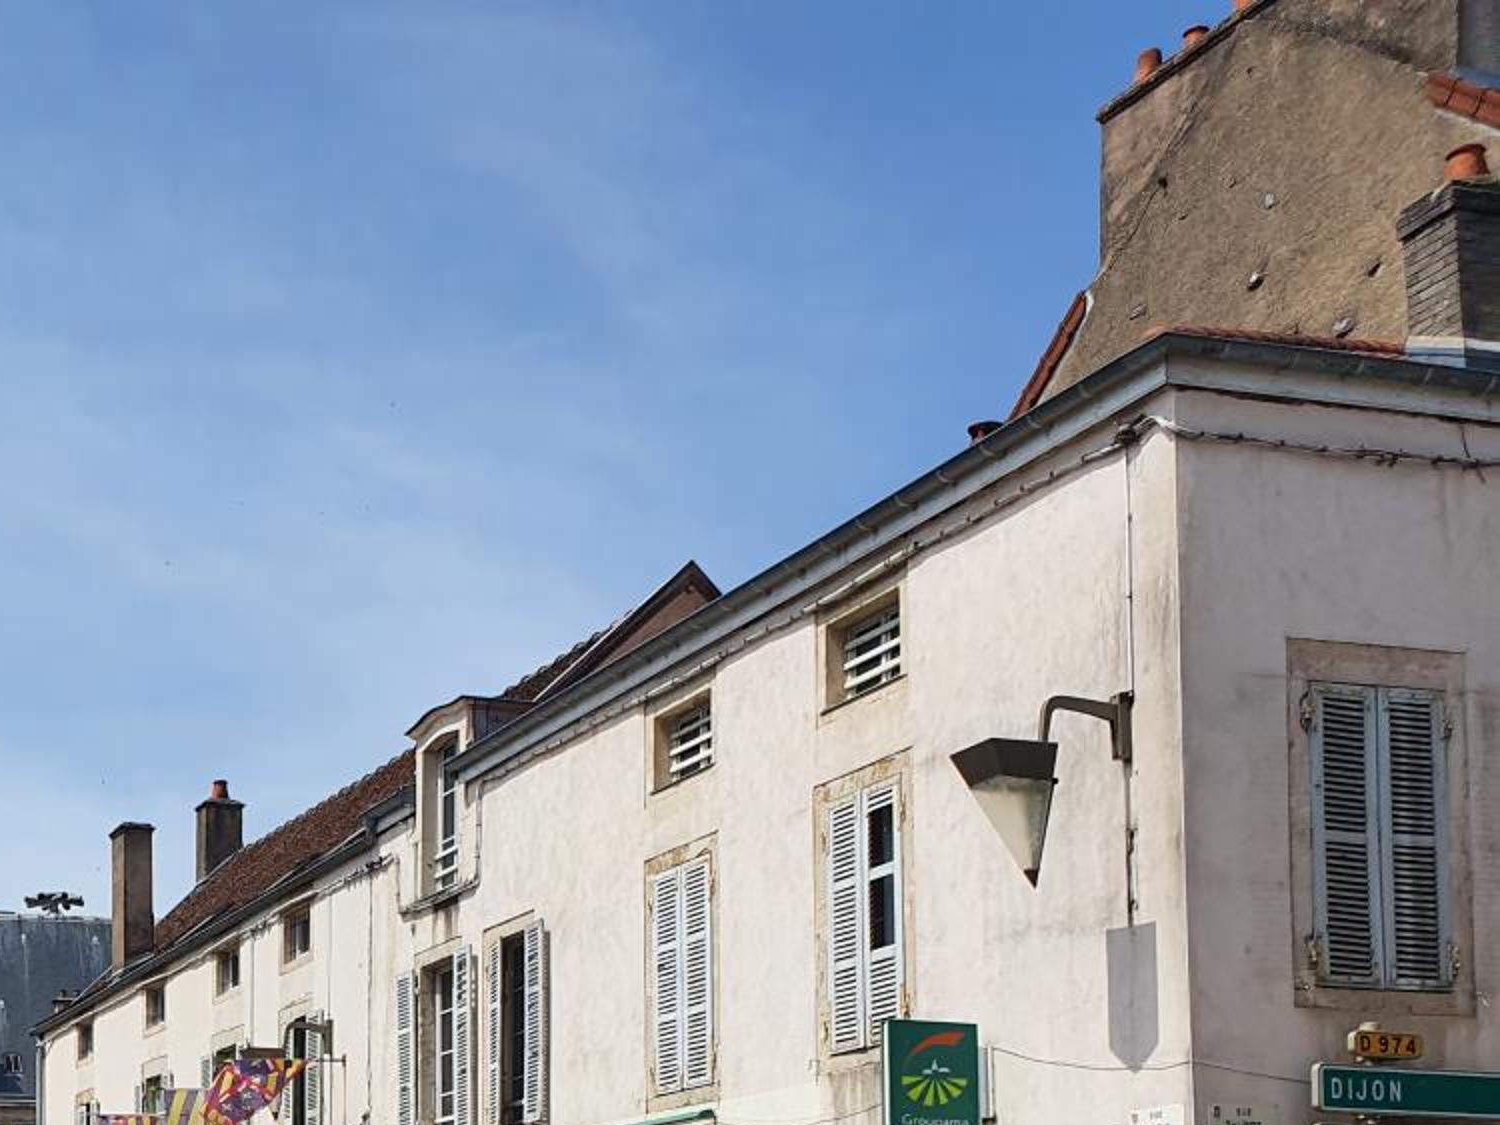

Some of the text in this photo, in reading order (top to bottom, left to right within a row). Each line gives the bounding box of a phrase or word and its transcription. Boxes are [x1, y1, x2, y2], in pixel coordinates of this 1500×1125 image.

[1360, 1035, 1417, 1055] D 974
[1330, 1077, 1402, 1102] DIJON
